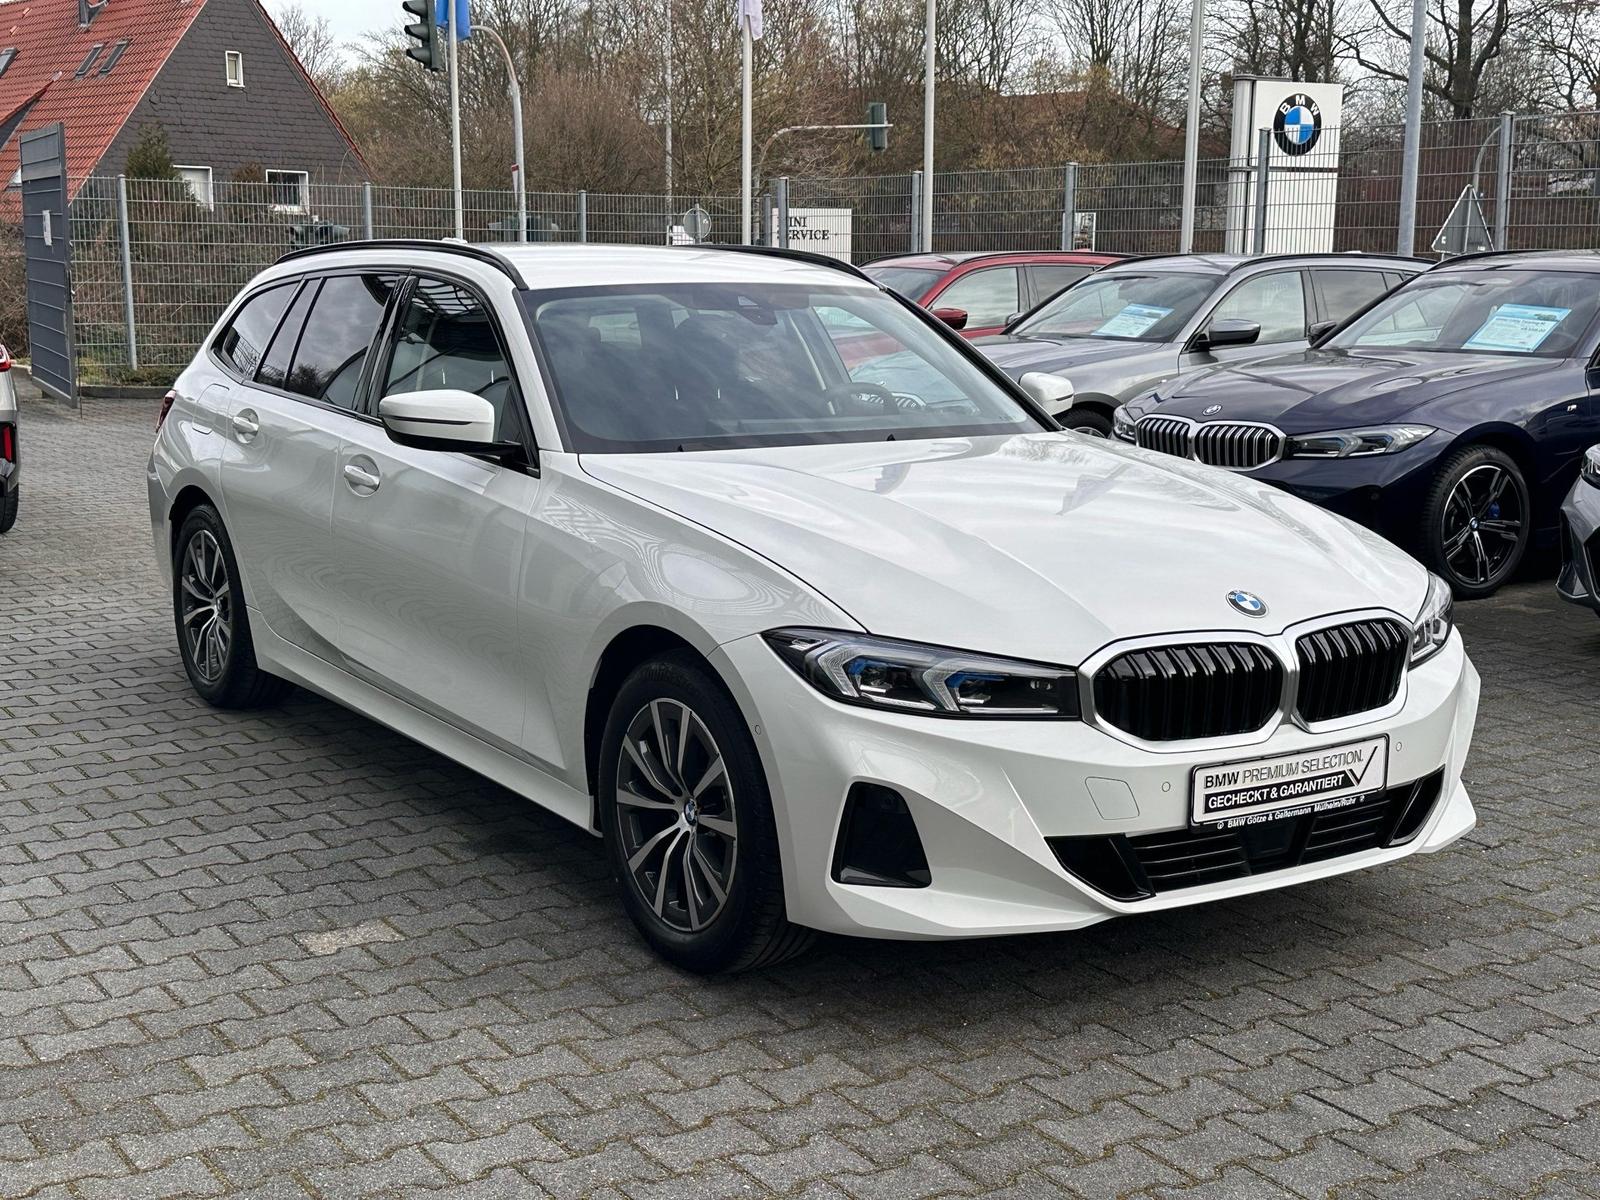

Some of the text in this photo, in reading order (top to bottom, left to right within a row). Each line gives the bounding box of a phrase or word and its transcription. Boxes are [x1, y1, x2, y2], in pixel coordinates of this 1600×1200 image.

[1280, 94, 1320, 116] BMW
[777, 216, 807, 228] INI
[777, 229, 829, 240] RVICE
[1204, 771, 1239, 789] BMW
[1242, 761, 1299, 783] PREMIUM
[1208, 773, 1345, 808] GECHECKT & GARANTIERT
[1227, 818, 1246, 828] BMW
[1247, 815, 1267, 825] Götze
